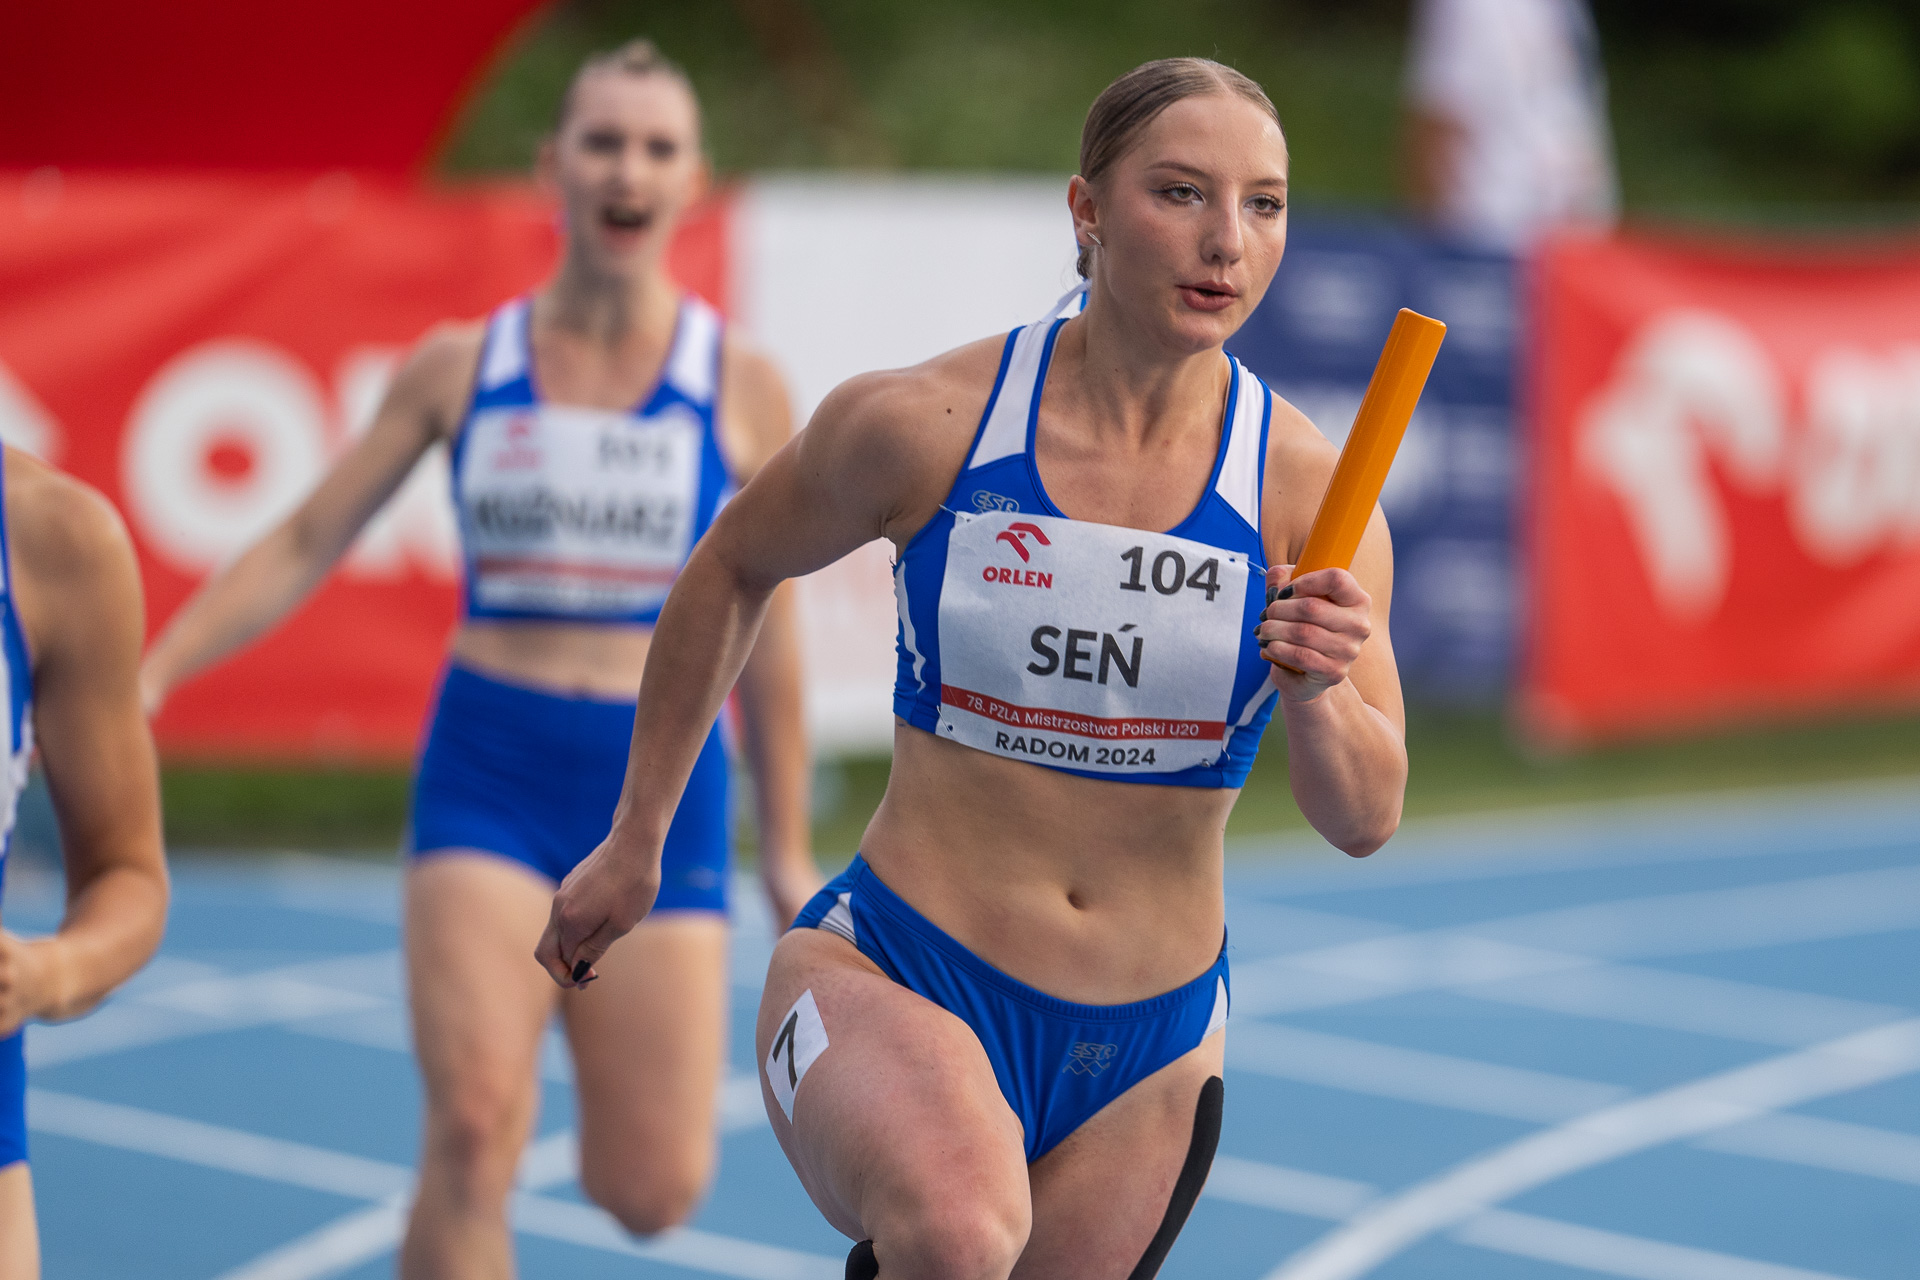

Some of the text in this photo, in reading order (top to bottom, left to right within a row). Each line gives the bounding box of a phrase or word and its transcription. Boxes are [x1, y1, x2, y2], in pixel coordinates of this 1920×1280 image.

[982, 565, 1054, 590] ORLEN
[1119, 545, 1221, 602] 104
[1026, 623, 1144, 689] SEŃ
[966, 694, 1200, 737] 78. PZLA Mistrzostwa Polski U20
[995, 730, 1157, 766] RADOM 2024
